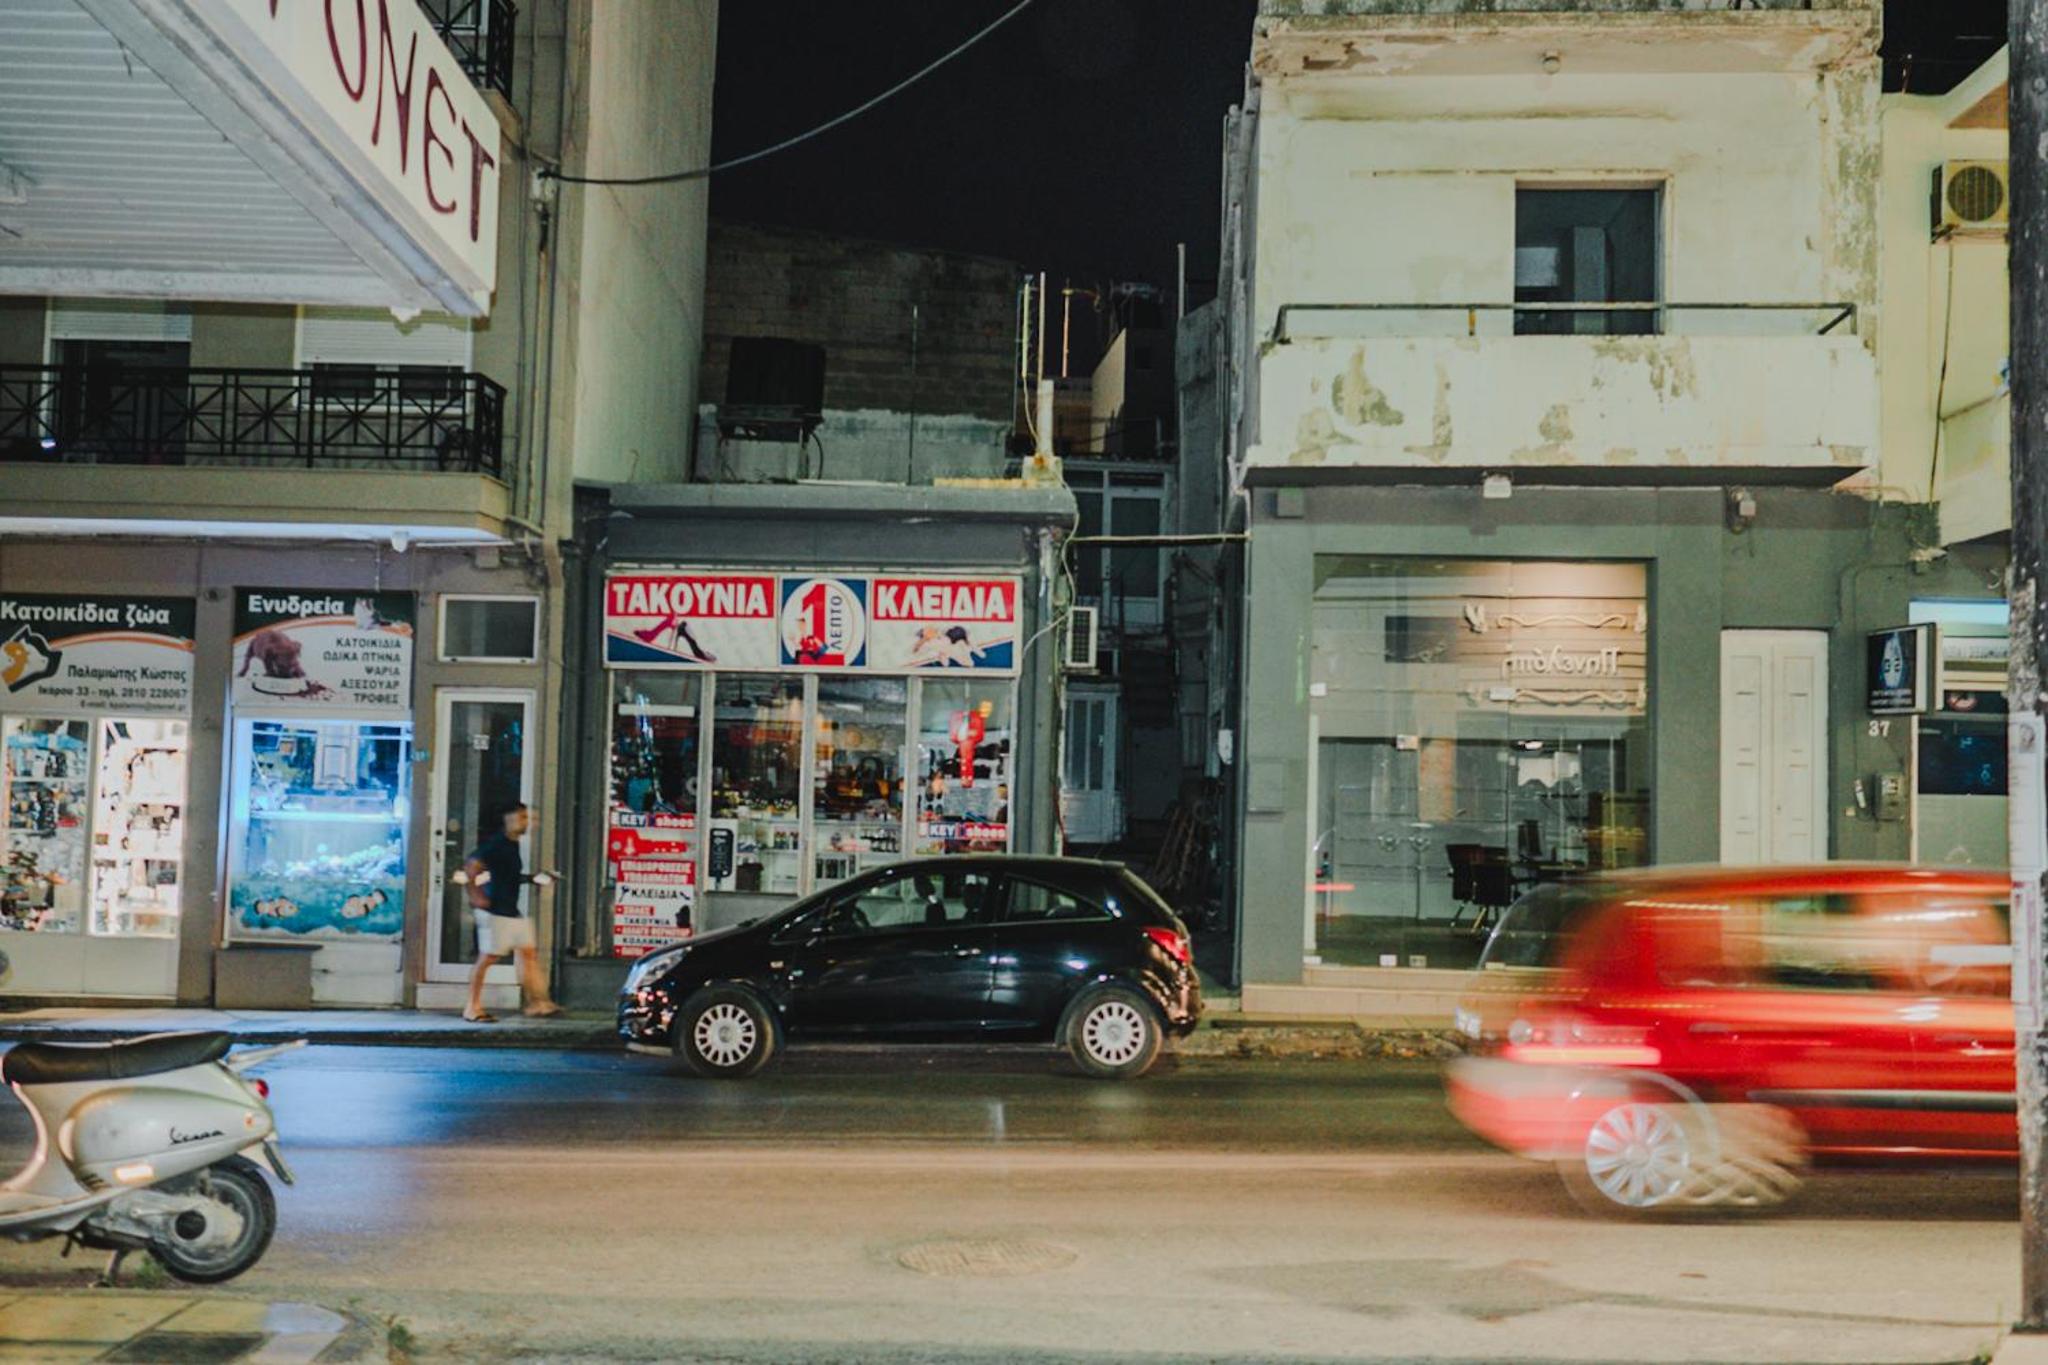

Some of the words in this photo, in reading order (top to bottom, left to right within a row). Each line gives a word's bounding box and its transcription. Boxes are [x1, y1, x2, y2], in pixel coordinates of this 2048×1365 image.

[269, 0, 495, 243] ONET
[612, 582, 768, 615] ΤΑΚΟΥΝΙΑ
[877, 584, 1008, 619] ΚΛΕΙΔΙΑ
[248, 594, 345, 618] Ενυδρεία
[1, 601, 119, 623] Κατοικίδια
[126, 604, 170, 627] ζώα
[830, 595, 842, 650] ΛΕΠΤΟ
[336, 637, 401, 649] ΚΑΤΟΙΚΙΔΙΑ
[323, 651, 359, 662] ΩΔΙΚΑ
[361, 652, 401, 663] ΠΤΗΝΑ
[365, 665, 400, 676] ΨΑΡΙΑ
[340, 678, 400, 690] ΑΞΕΣΟΥΑΡ
[76, 686, 89, 696] 33
[354, 692, 399, 704] ΤΡΟΦΕΣ
[621, 814, 647, 826] KEY
[656, 816, 695, 827] shoes
[929, 824, 956, 837] KEY
[631, 888, 679, 900] ΚΛΕΙΔΙΑ
